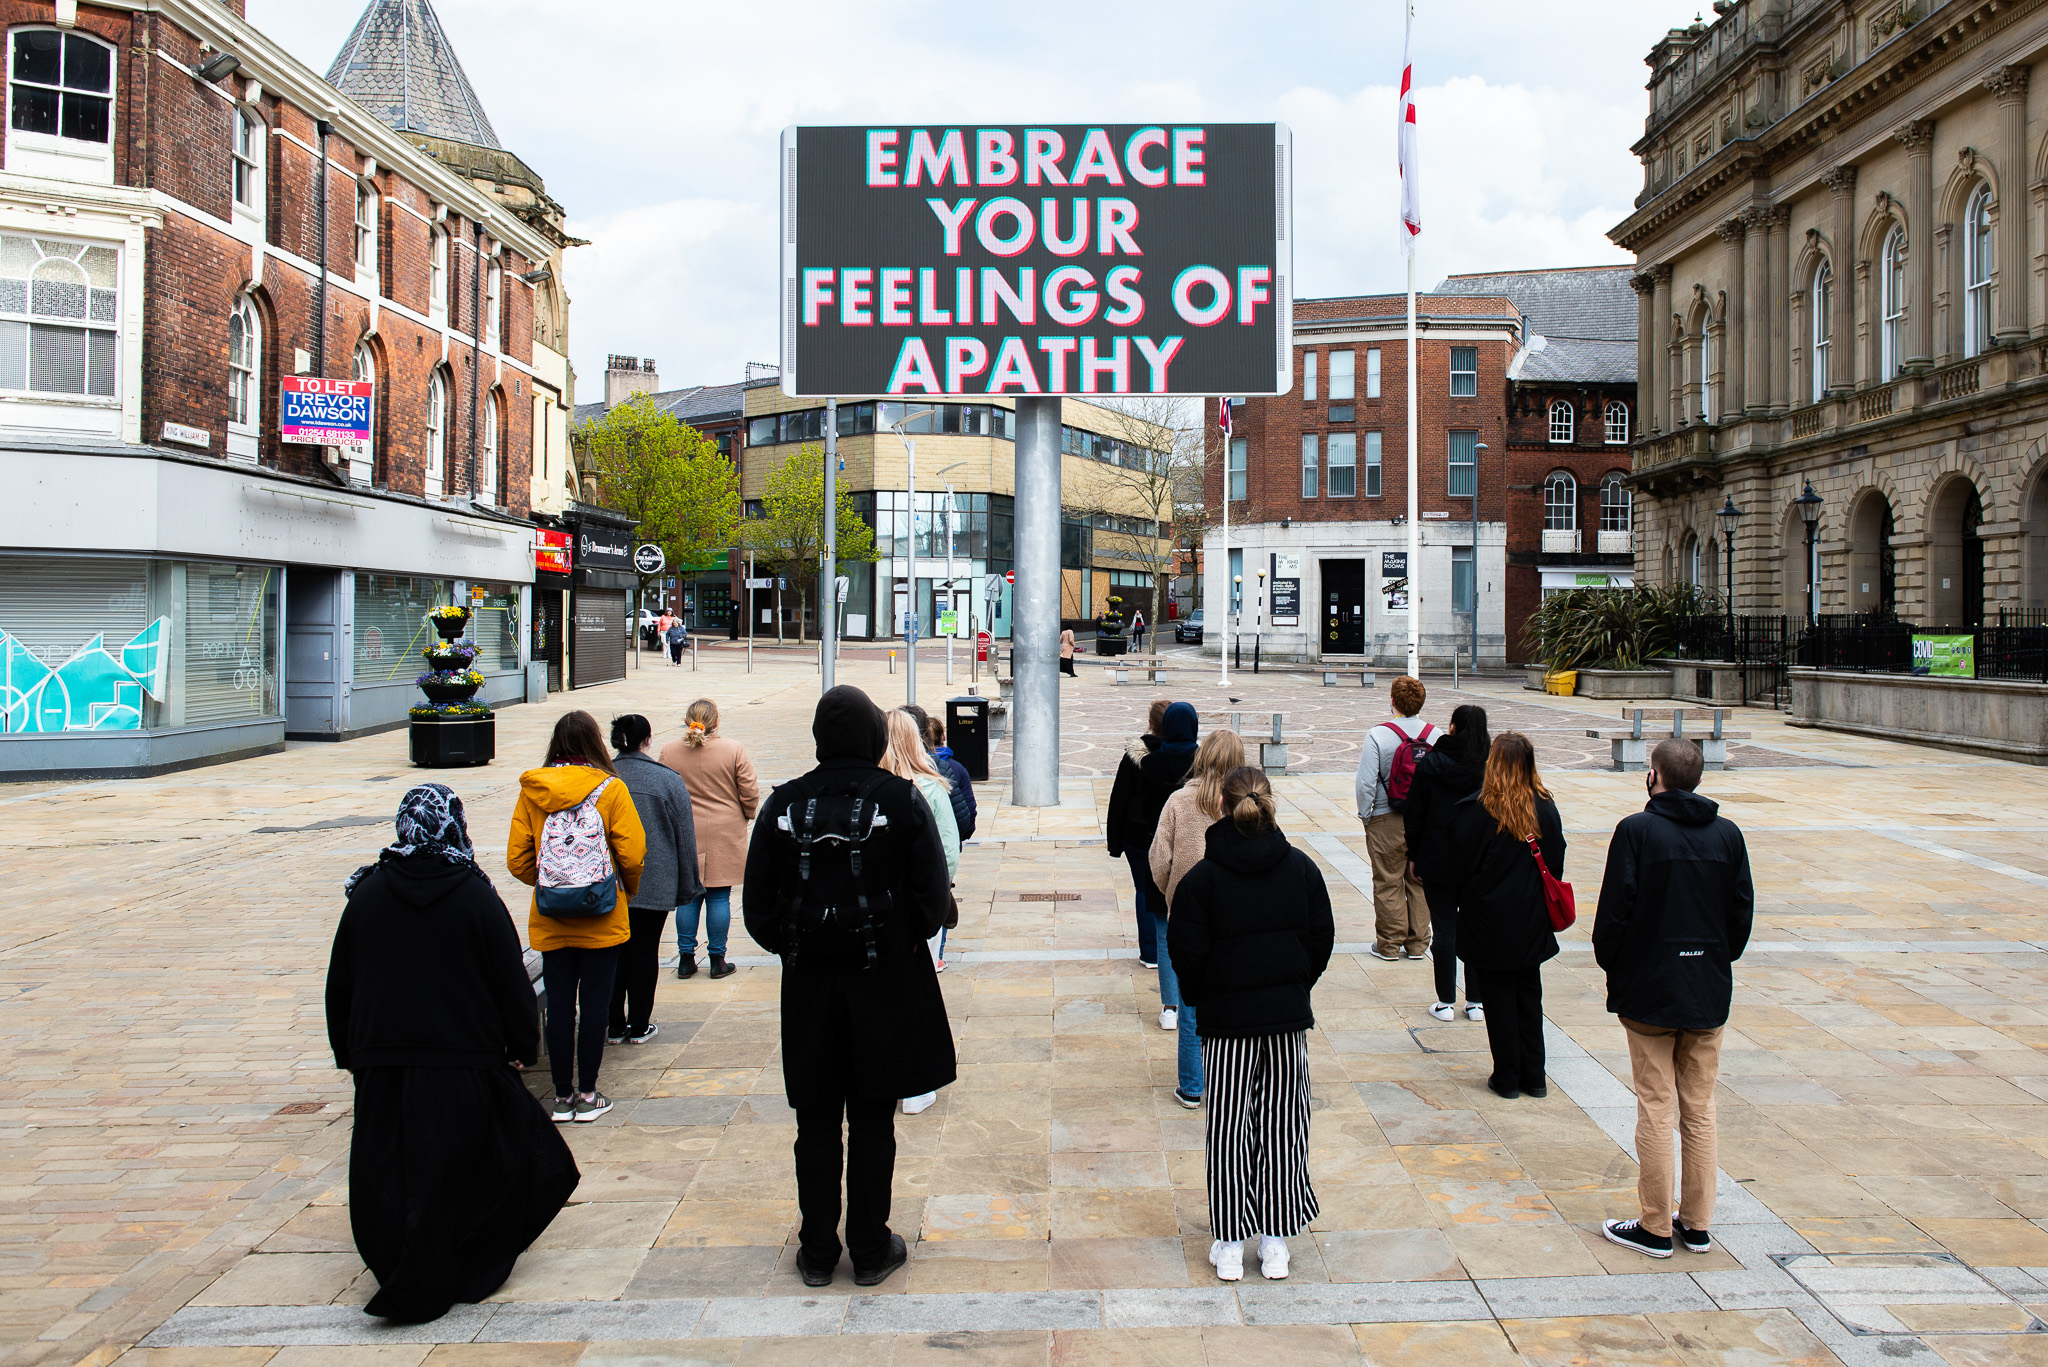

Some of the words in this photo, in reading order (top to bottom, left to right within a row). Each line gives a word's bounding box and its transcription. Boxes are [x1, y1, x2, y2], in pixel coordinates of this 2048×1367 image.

[866, 127, 1206, 188] EMBRACE
[926, 196, 1144, 257] YOUR
[802, 265, 1145, 327] FEELINGS
[1171, 264, 1272, 327] OF
[885, 336, 1186, 394] APATHY
[296, 378, 321, 393] TO
[324, 380, 357, 395] LET
[288, 391, 365, 410] TREVOR
[287, 404, 366, 422] DAWSON
[166, 426, 178, 436] KING
[180, 429, 200, 441] WILLIAM
[201, 433, 208, 443] ST
[290, 435, 317, 443] PRICE
[320, 437, 362, 446] REDUCED
[298, 428, 325, 437] 01254
[326, 429, 356, 439] 681133
[1577, 577, 1606, 585] inspire
[1913, 640, 1934, 659] COVID
